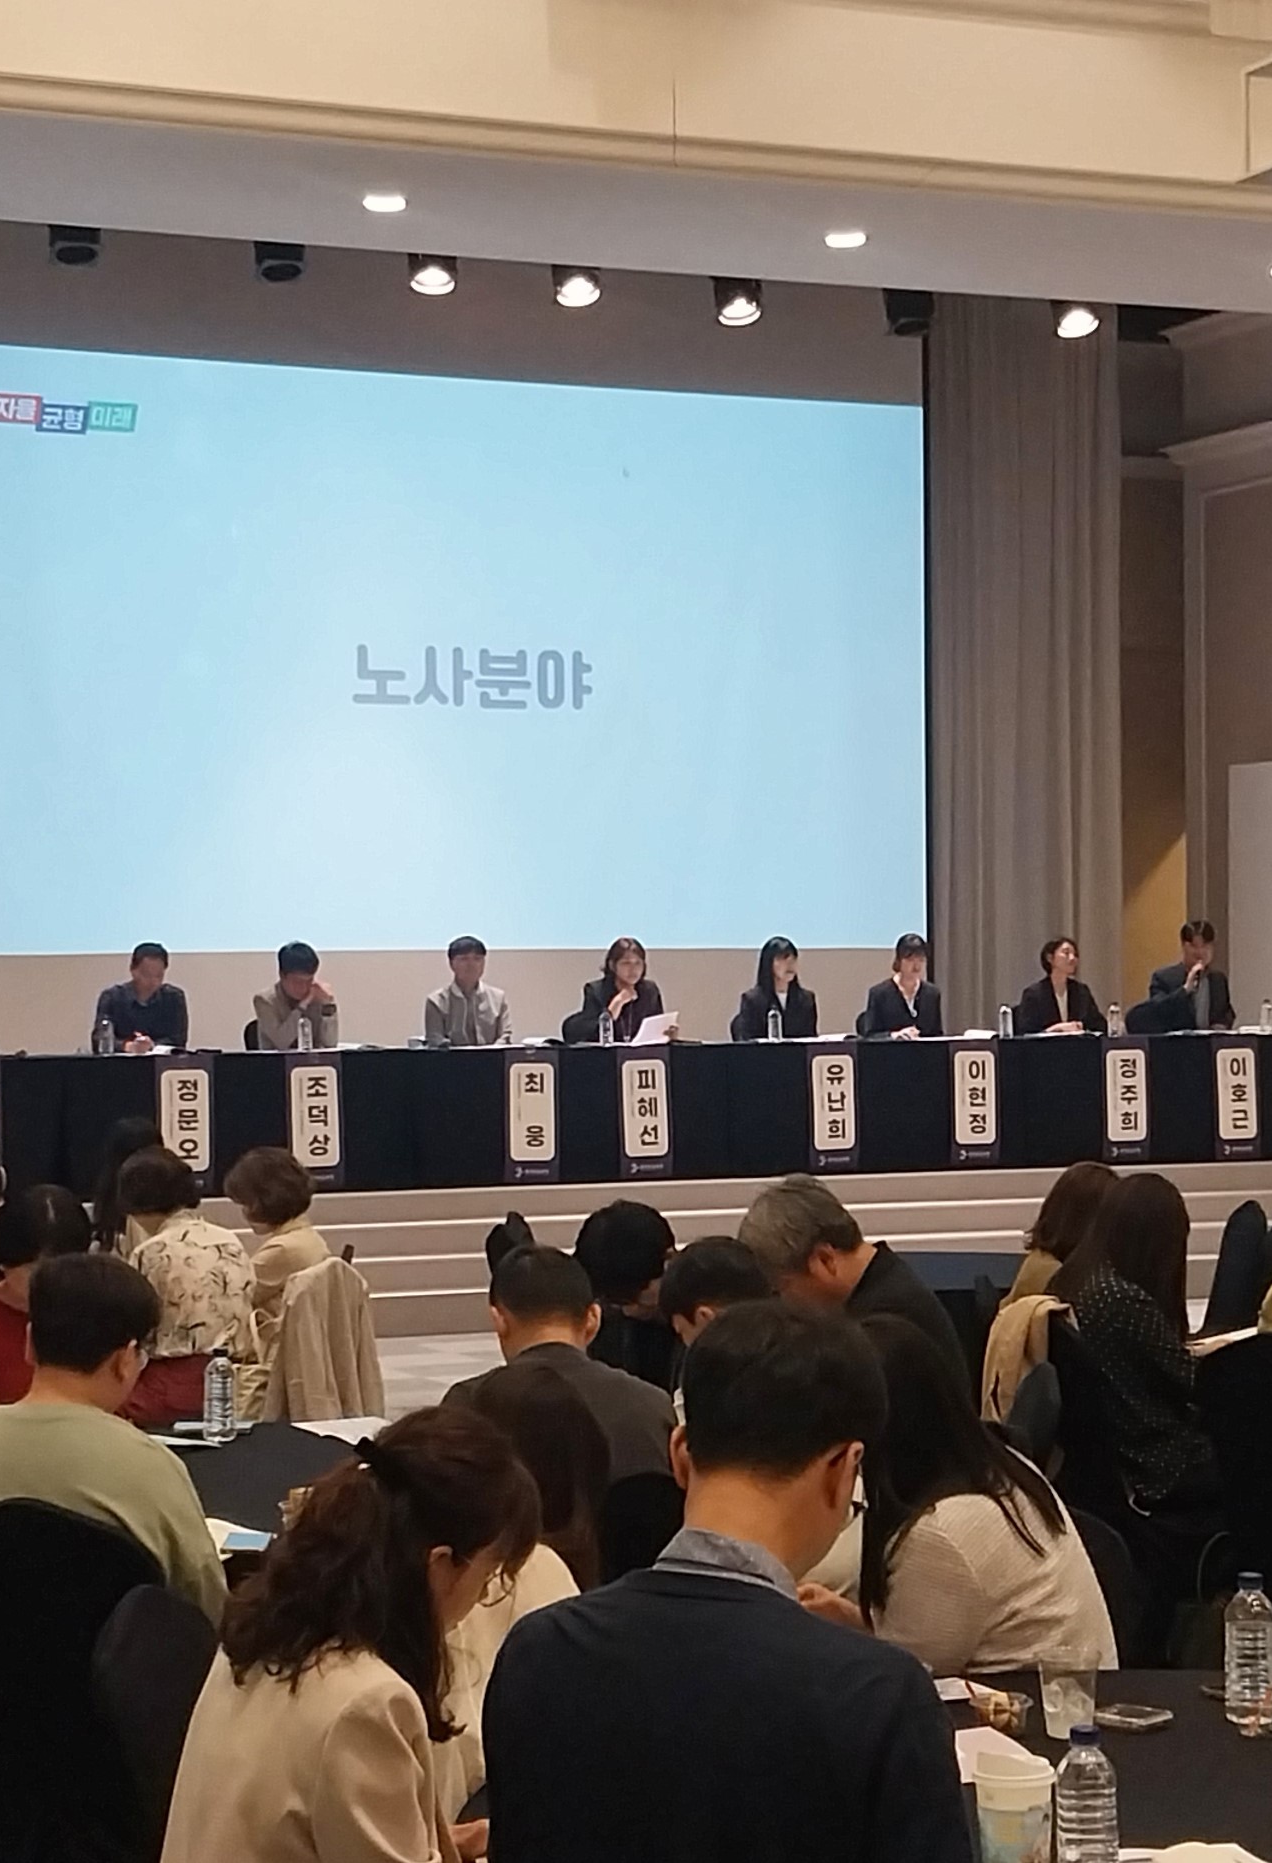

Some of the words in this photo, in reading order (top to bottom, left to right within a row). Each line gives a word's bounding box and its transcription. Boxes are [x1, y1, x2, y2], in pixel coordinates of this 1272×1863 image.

[42, 407, 85, 431] 균형
[91, 406, 132, 428] 미래
[352, 643, 593, 710] 노사분야
[176, 1078, 200, 1160] 정문오
[306, 1076, 331, 1157] 조덕상
[826, 1064, 847, 1139] 유난희
[967, 1059, 987, 1135] 이현정
[1119, 1058, 1139, 1131] 정주희
[1229, 1056, 1249, 1130] 이호근
